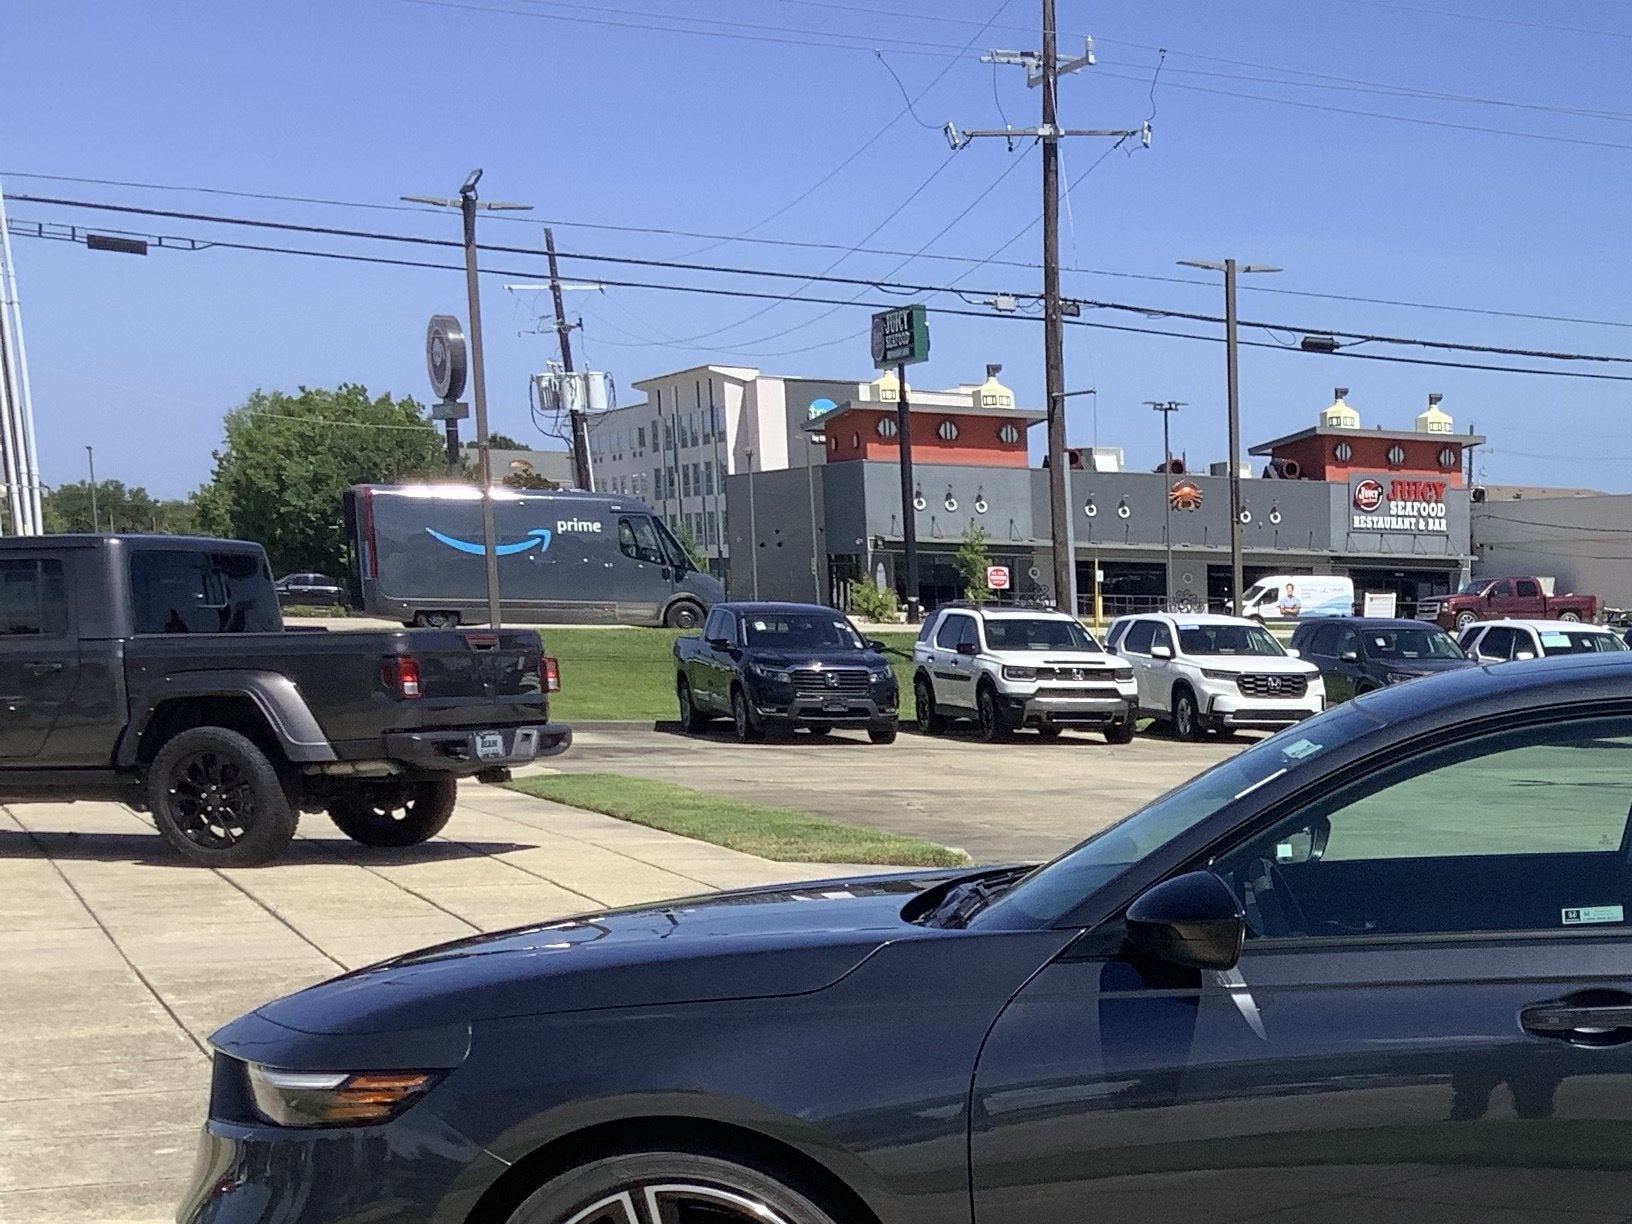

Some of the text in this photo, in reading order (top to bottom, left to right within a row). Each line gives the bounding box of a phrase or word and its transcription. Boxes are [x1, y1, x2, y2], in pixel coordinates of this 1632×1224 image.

[1387, 480, 1446, 502] JUICY
[1389, 501, 1446, 517] SEAFOOD
[557, 517, 602, 535] prime
[1353, 516, 1447, 531] RESTAURANT & BAR
